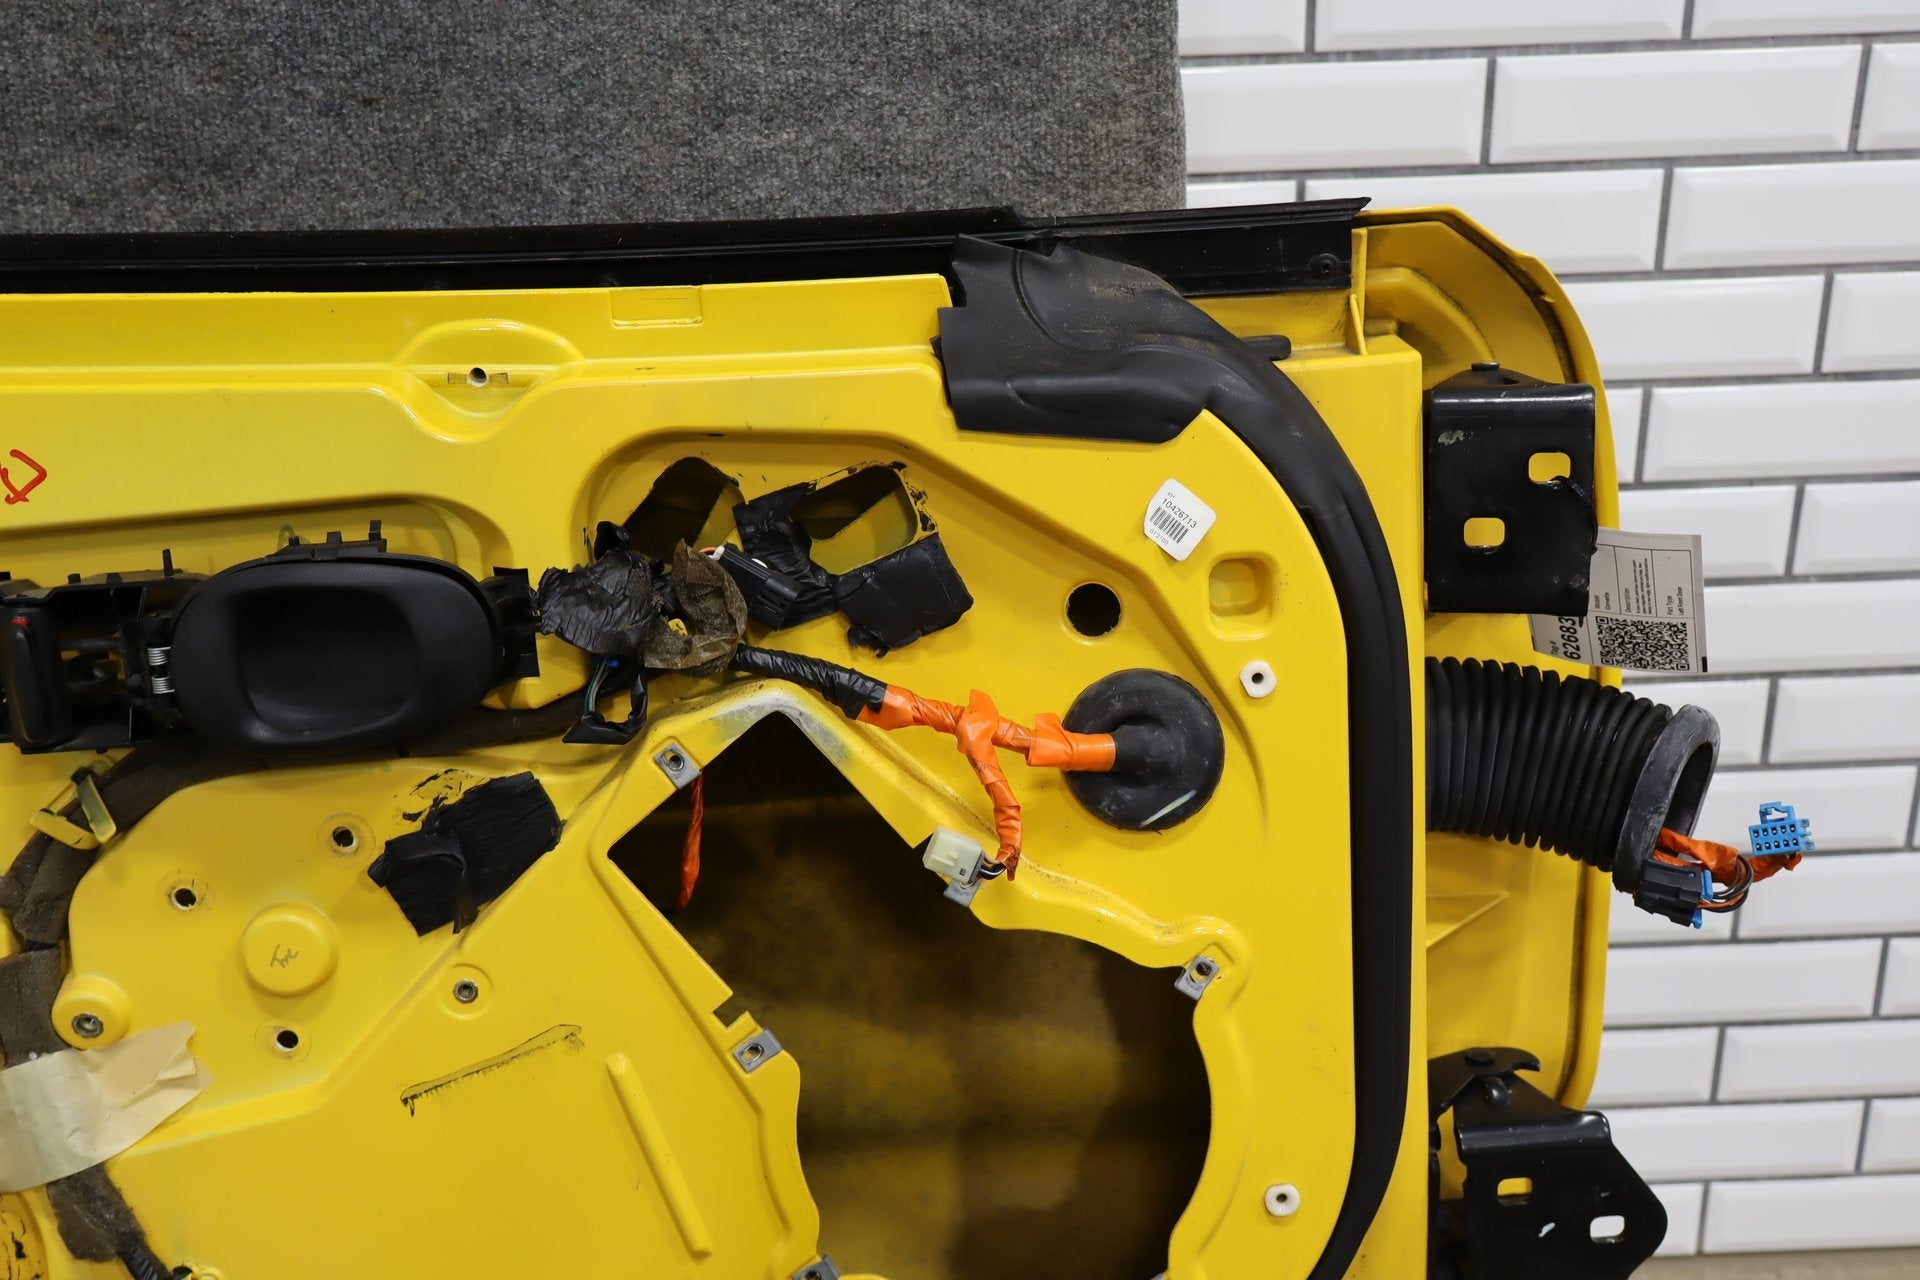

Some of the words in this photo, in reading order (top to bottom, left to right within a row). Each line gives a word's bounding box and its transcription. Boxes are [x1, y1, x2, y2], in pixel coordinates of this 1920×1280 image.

[1162, 498, 1197, 529] 10426713
[1624, 587, 1632, 613] Description
[1666, 596, 1674, 606] Type
[1551, 646, 1559, 655] Tag
[1558, 616, 1581, 660] 62683
